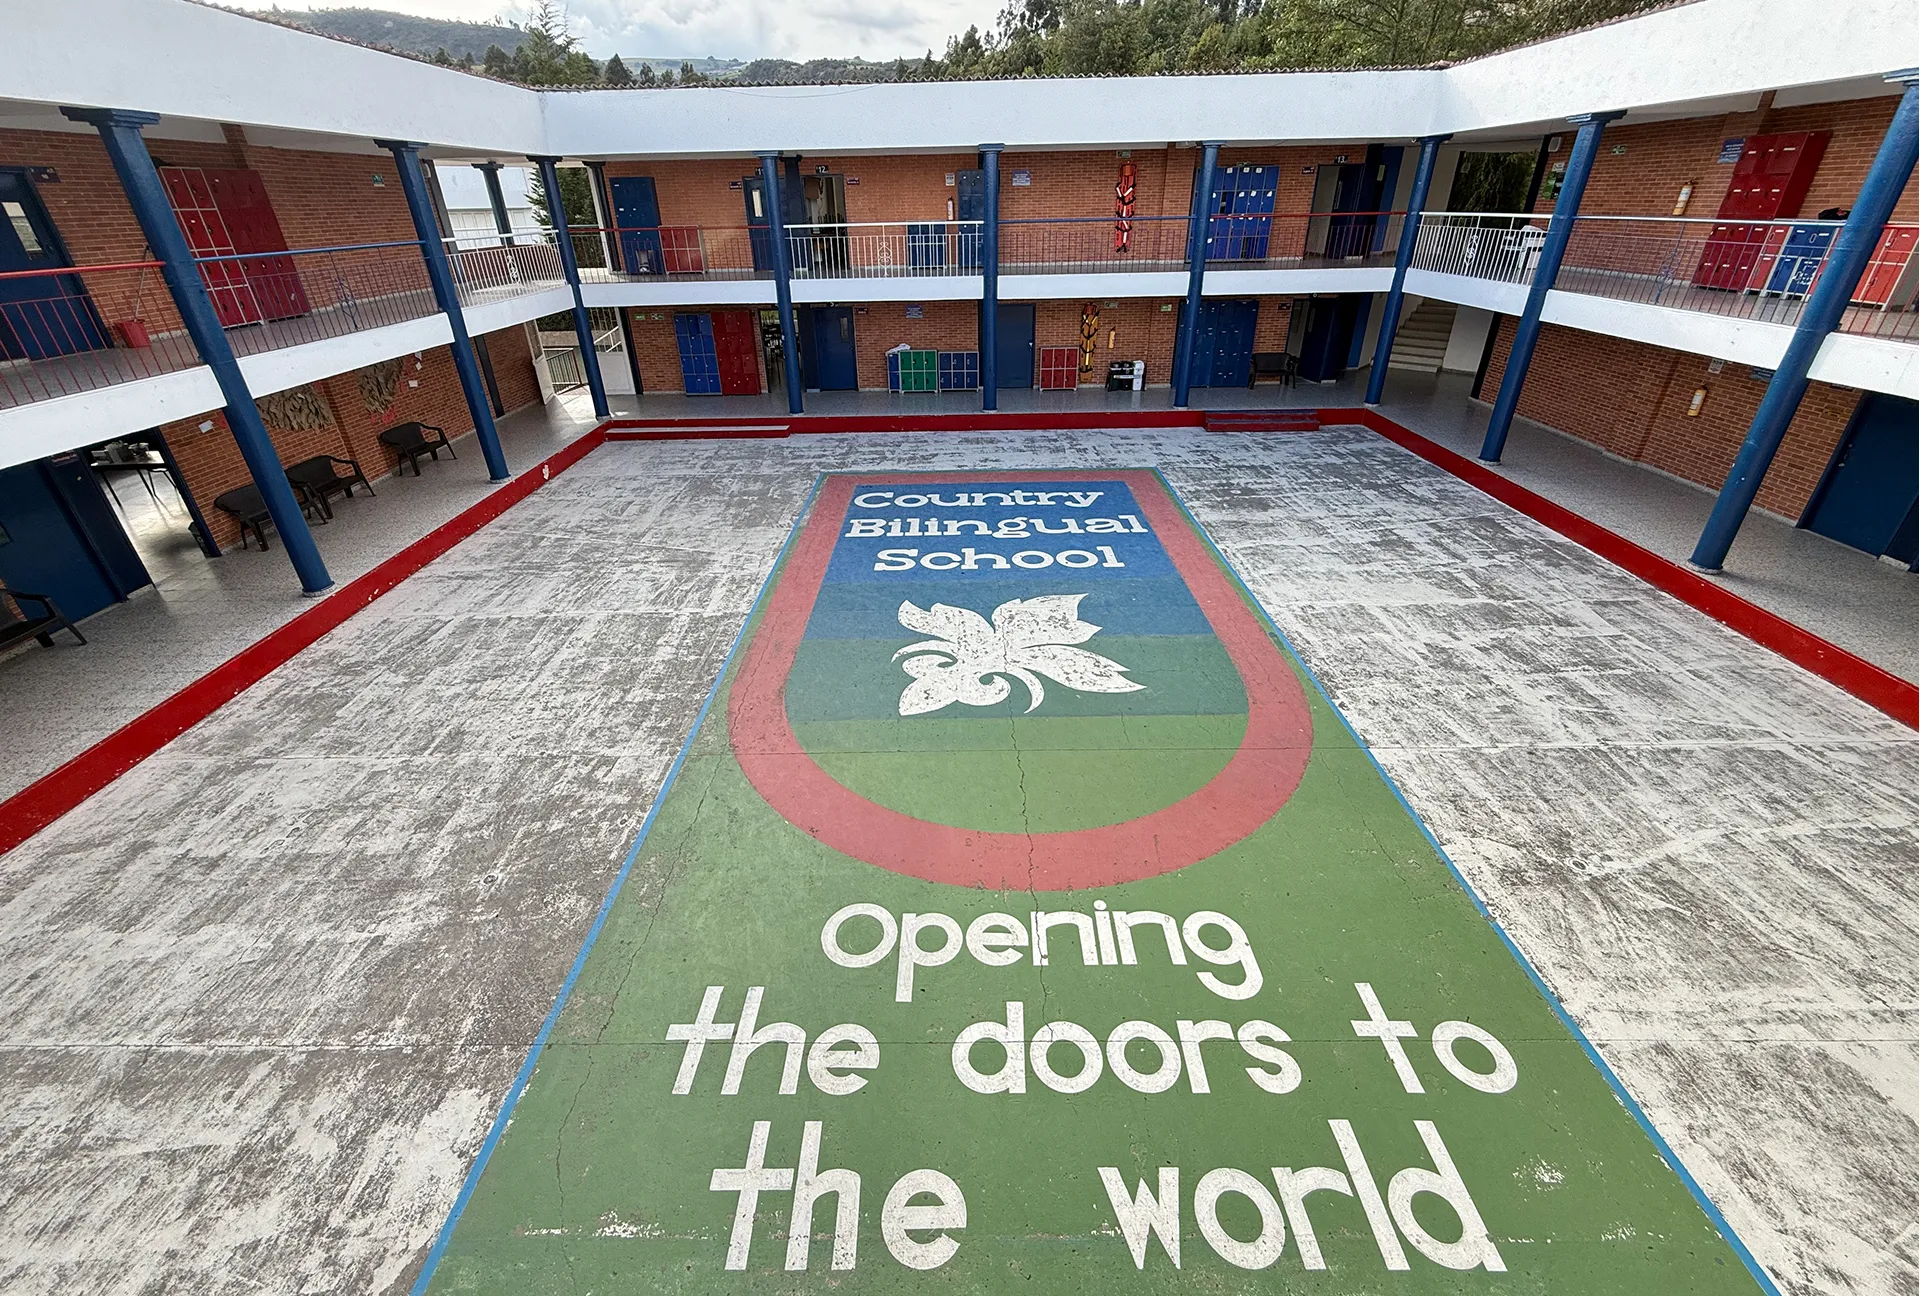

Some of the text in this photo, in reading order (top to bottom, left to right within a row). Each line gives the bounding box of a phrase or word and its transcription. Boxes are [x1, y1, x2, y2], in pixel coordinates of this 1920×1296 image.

[853, 490, 1104, 508] Country
[844, 515, 1149, 539] Bilingual
[873, 545, 1126, 572] School
[664, 982, 1519, 1096] the doors to
[709, 1118, 1509, 1272] the world
